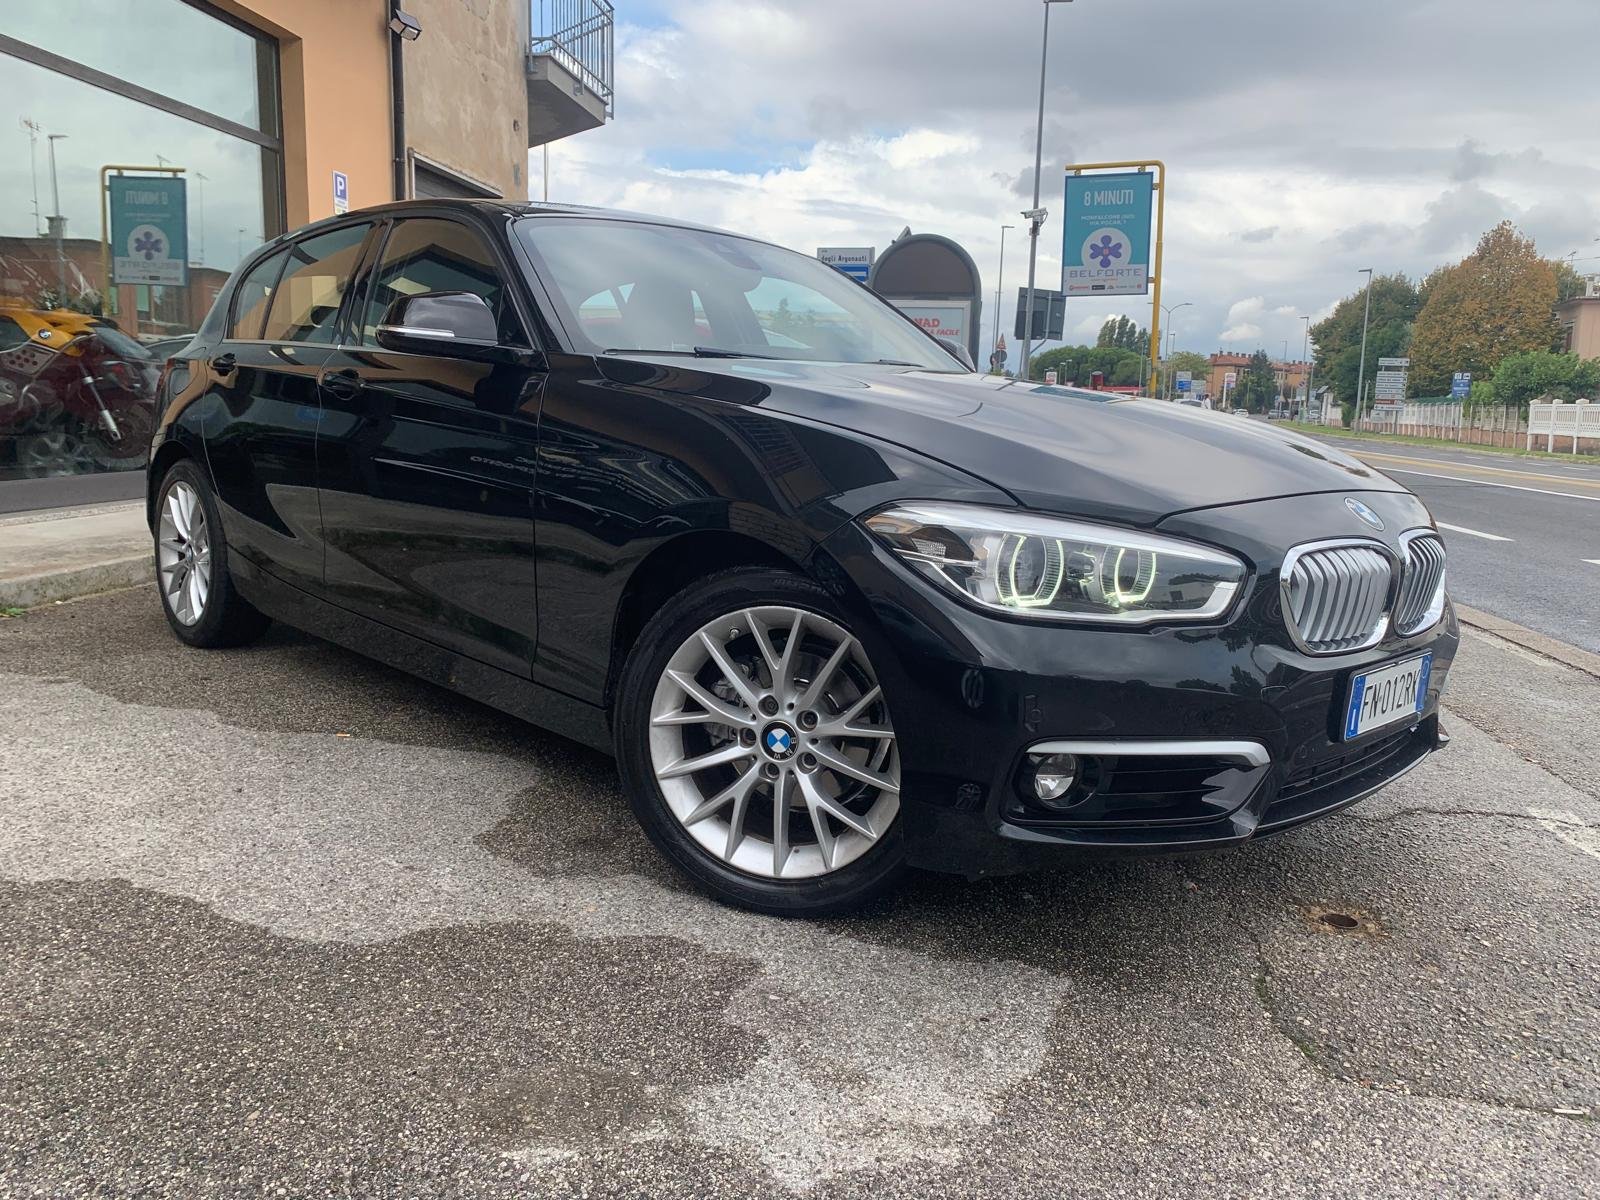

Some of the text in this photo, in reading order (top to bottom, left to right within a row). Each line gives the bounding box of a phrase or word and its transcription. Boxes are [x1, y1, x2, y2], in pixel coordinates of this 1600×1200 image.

[336, 176, 345, 196] P
[1084, 189, 1134, 206] 8 MINUTI
[1070, 268, 1142, 278] BELFORTE
